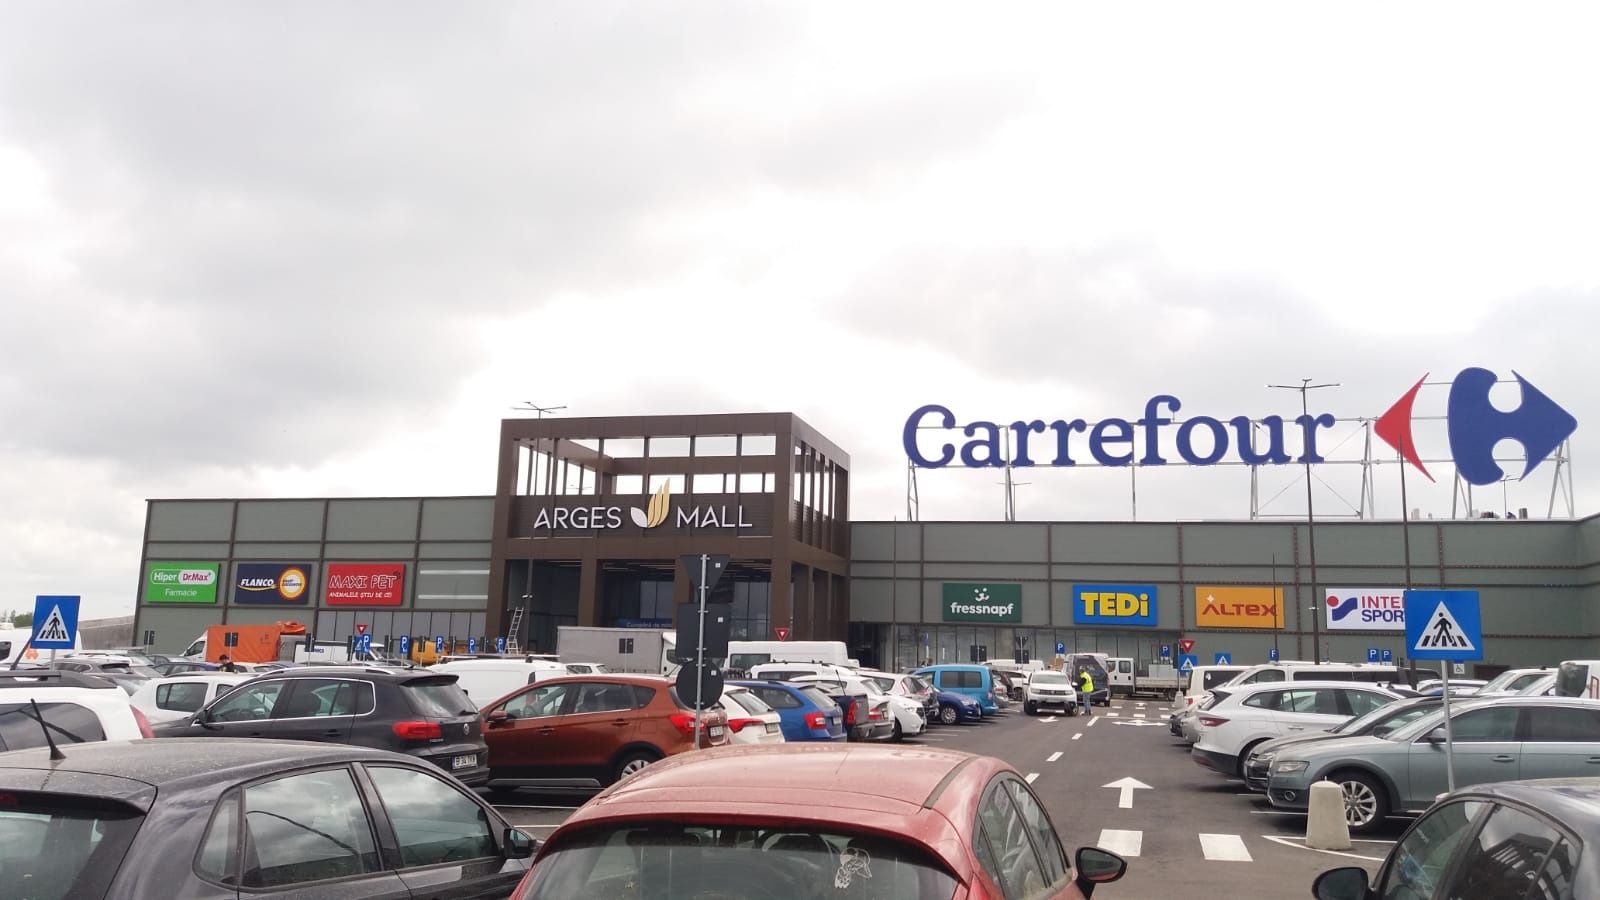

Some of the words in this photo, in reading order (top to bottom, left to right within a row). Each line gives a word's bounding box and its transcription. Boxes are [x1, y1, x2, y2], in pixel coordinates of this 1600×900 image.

[902, 394, 1336, 468] Carrefour
[533, 506, 622, 529] ARGES
[676, 505, 753, 529] MALL
[154, 571, 177, 582] Hiper
[240, 578, 274, 587] FLANCO
[328, 575, 368, 589] MAXI
[370, 574, 397, 589] PET
[164, 588, 198, 597] Farmacie
[950, 601, 1014, 617] fressnapf
[1080, 592, 1149, 617] TEDi
[1361, 609, 1405, 623] SPOR
[1057, 643, 1064, 651] P
[1369, 649, 1377, 658] P
[1383, 650, 1390, 658] P
